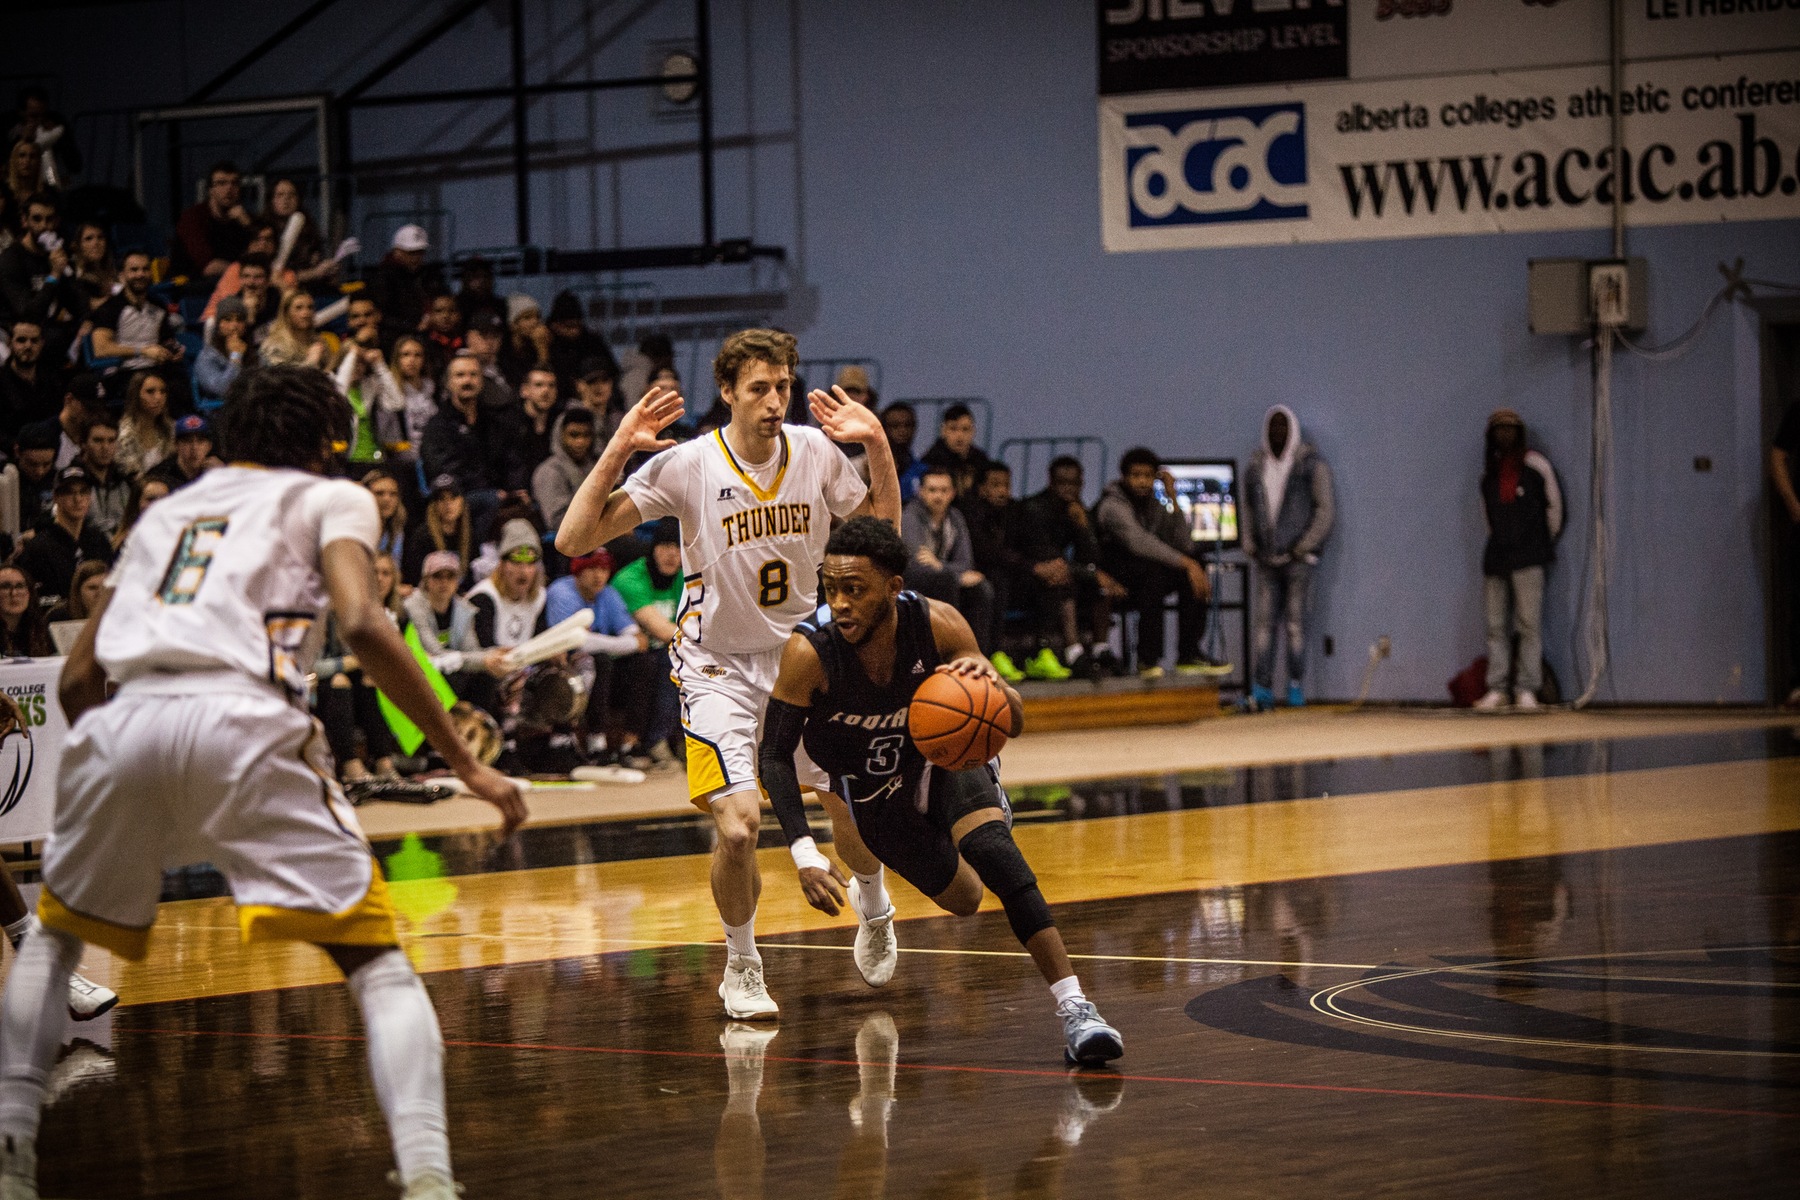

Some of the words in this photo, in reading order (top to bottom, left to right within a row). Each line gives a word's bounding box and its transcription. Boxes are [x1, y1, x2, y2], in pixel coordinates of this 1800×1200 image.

[1105, 28, 1267, 63] SPONSORSHIP
[1269, 22, 1341, 49] LEVEL
[1336, 101, 1429, 132] alberta
[1441, 94, 1556, 128] colleges
[1568, 82, 1670, 117] athetic
[1126, 111, 1306, 219] acac
[1338, 112, 1800, 217] www.acac.ab.
[722, 503, 810, 547] THUNDER
[154, 515, 230, 605] 6
[758, 559, 789, 608] 8
[7, 684, 46, 696] COLLEGE
[865, 734, 905, 775] 3
